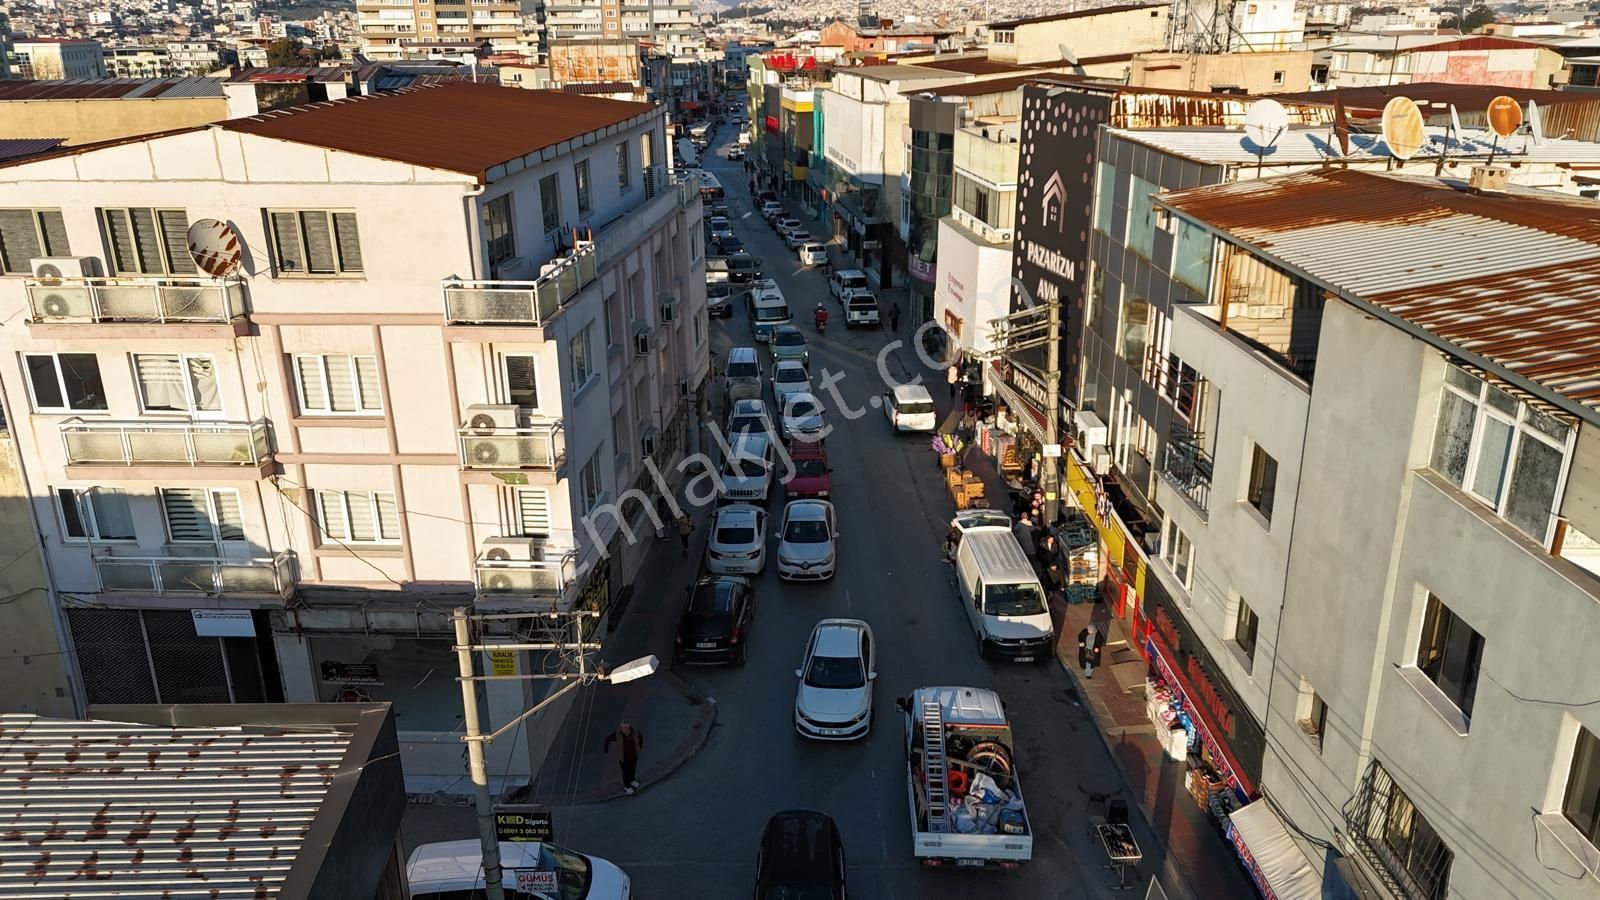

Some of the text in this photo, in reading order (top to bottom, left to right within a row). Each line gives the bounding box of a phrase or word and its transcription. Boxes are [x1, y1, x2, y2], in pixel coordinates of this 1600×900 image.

[1027, 240, 1075, 281] PAZARİZM
[1037, 277, 1059, 300] AVM
[524, 818, 549, 826] Sigorta
